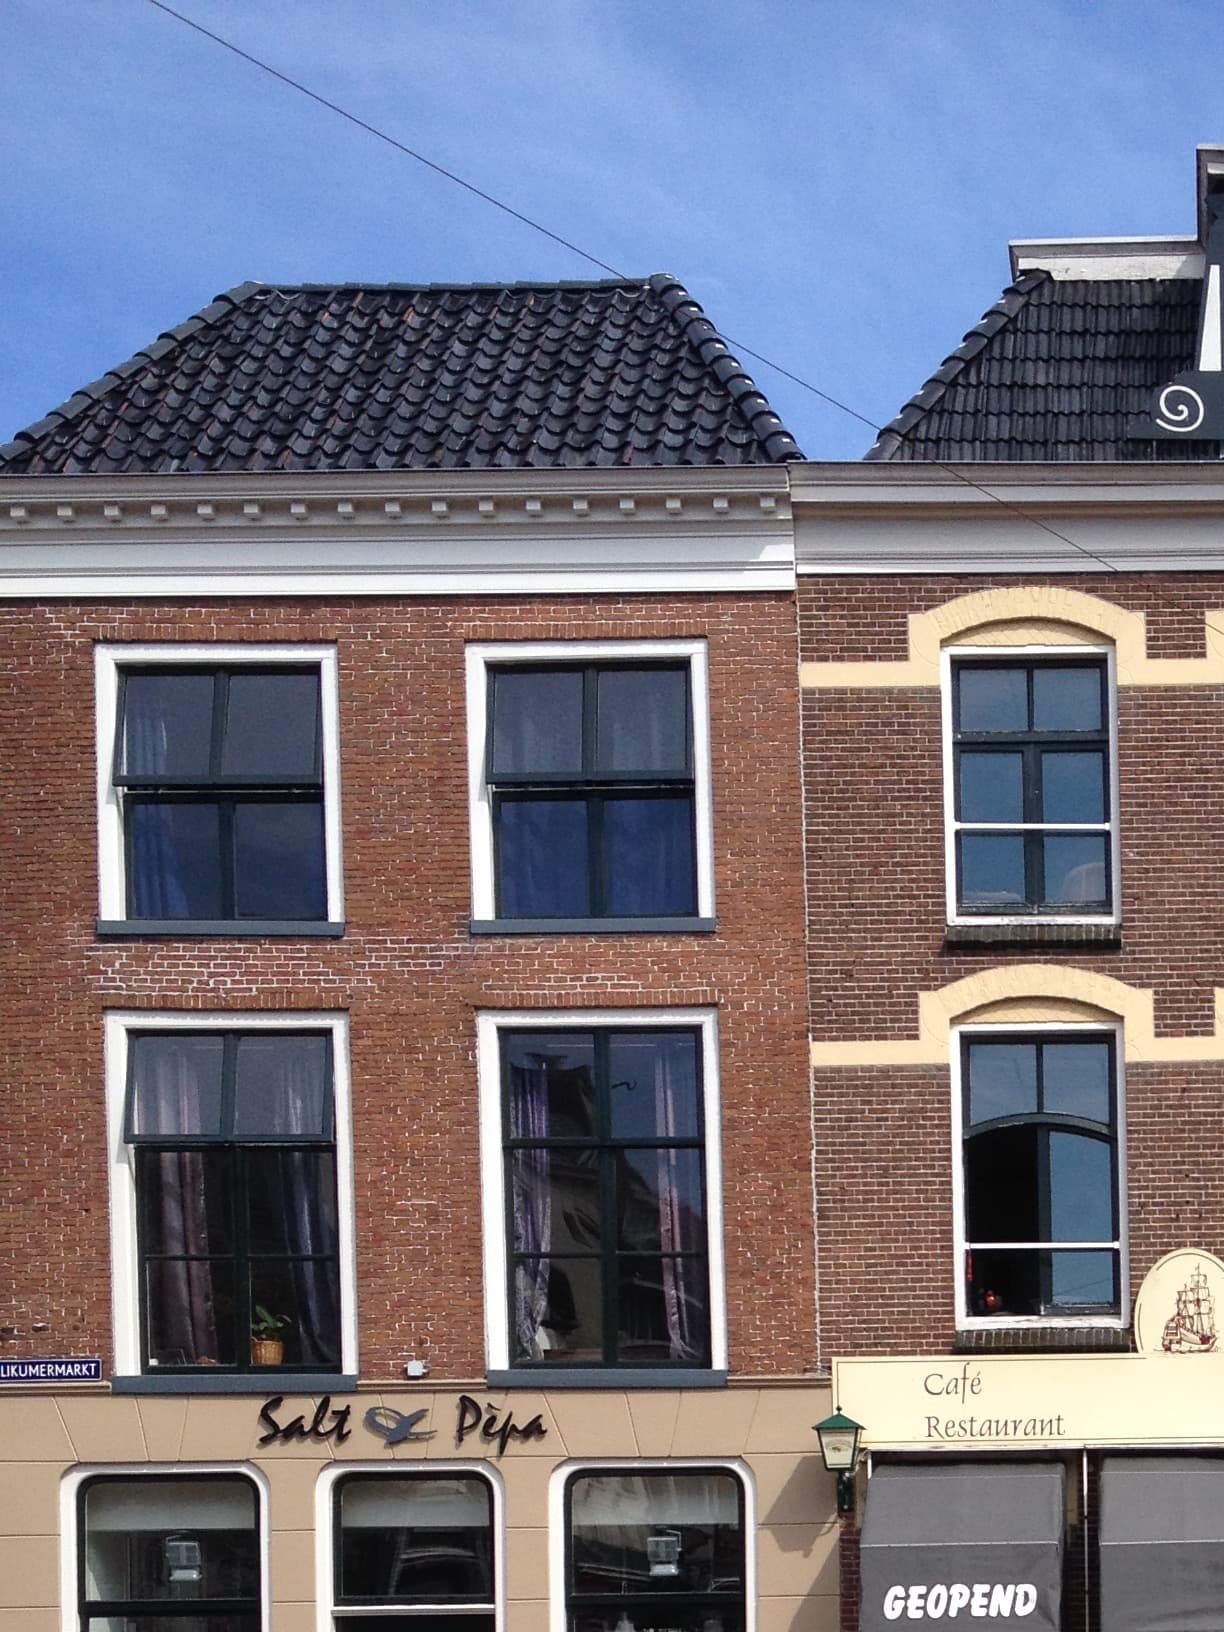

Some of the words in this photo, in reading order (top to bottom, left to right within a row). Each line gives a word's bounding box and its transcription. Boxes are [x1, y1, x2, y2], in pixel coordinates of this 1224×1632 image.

[924, 1361, 983, 1404] Café
[259, 1395, 352, 1443] Salt
[924, 1414, 1066, 1439] Restaurant
[883, 1583, 1038, 1620] GEOPEND
